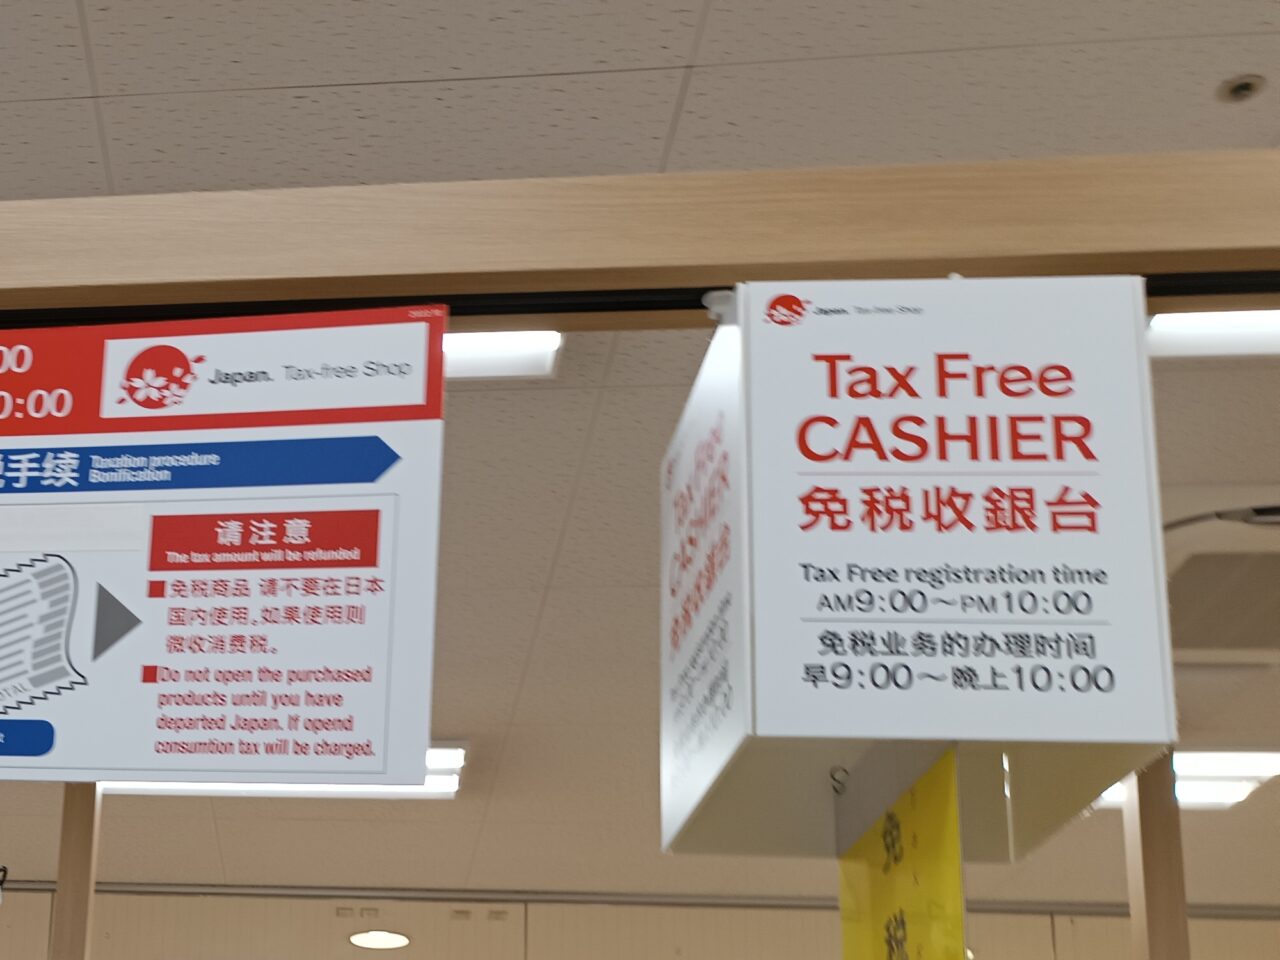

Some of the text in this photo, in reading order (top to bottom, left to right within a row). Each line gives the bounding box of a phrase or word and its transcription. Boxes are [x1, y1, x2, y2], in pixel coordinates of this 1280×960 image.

[207, 360, 413, 388] Japan. Tax-free Shop
[813, 352, 1075, 400] Tax Free
[796, 415, 1098, 463] CASHIER
[214, 517, 312, 546] 请注意
[166, 551, 189, 564] The
[190, 551, 211, 563] tax
[212, 550, 259, 563] amount
[260, 549, 284, 562] will
[285, 549, 303, 561] be
[170, 576, 385, 599] 免税商品 请不要在日本
[798, 562, 1109, 589] Tax Free registration time
[817, 629, 1097, 660] 免税业务的办理时间
[158, 665, 373, 686] Do not open the purchased
[157, 689, 344, 709] products until you have
[156, 714, 226, 733] departed
[230, 714, 283, 733] Japan.
[288, 714, 300, 730] If
[238, 739, 260, 755] tax
[263, 738, 289, 755] will
[293, 739, 311, 755] be
[313, 739, 376, 760] charged.
